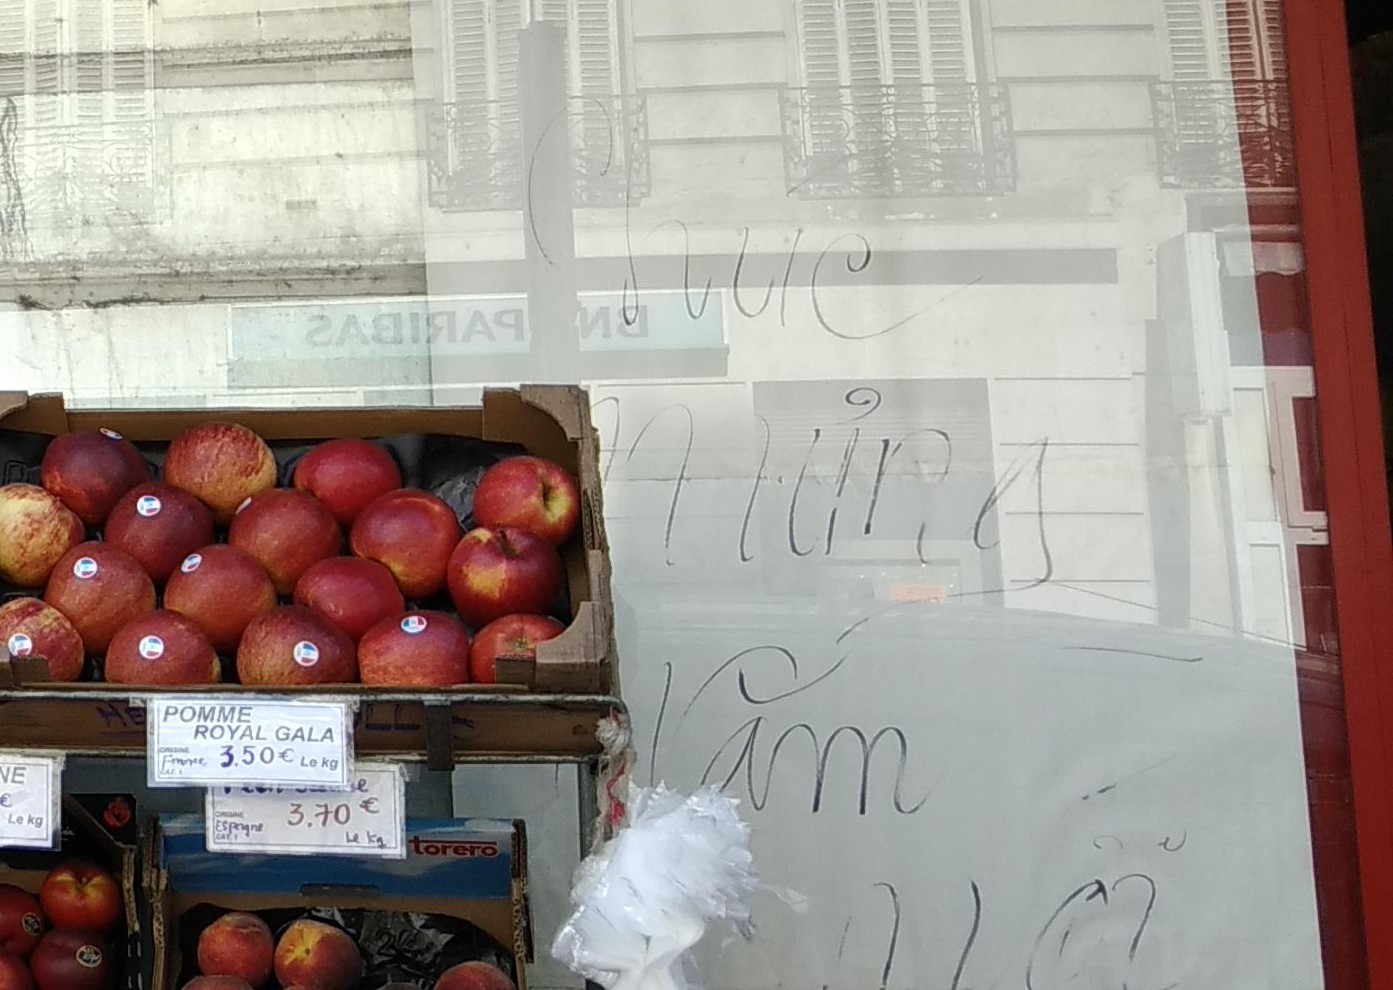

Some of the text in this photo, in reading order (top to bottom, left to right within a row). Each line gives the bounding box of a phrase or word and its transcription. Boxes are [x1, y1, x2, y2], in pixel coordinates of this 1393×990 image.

[162, 705, 253, 723] POMME
[193, 724, 335, 742] ROYAL GALA
[300, 756, 338, 771] Le kg
[7, 813, 43, 828] Le kg
[215, 821, 264, 840] Espagne
[346, 830, 387, 848] Le kg
[409, 836, 498, 856] torero
